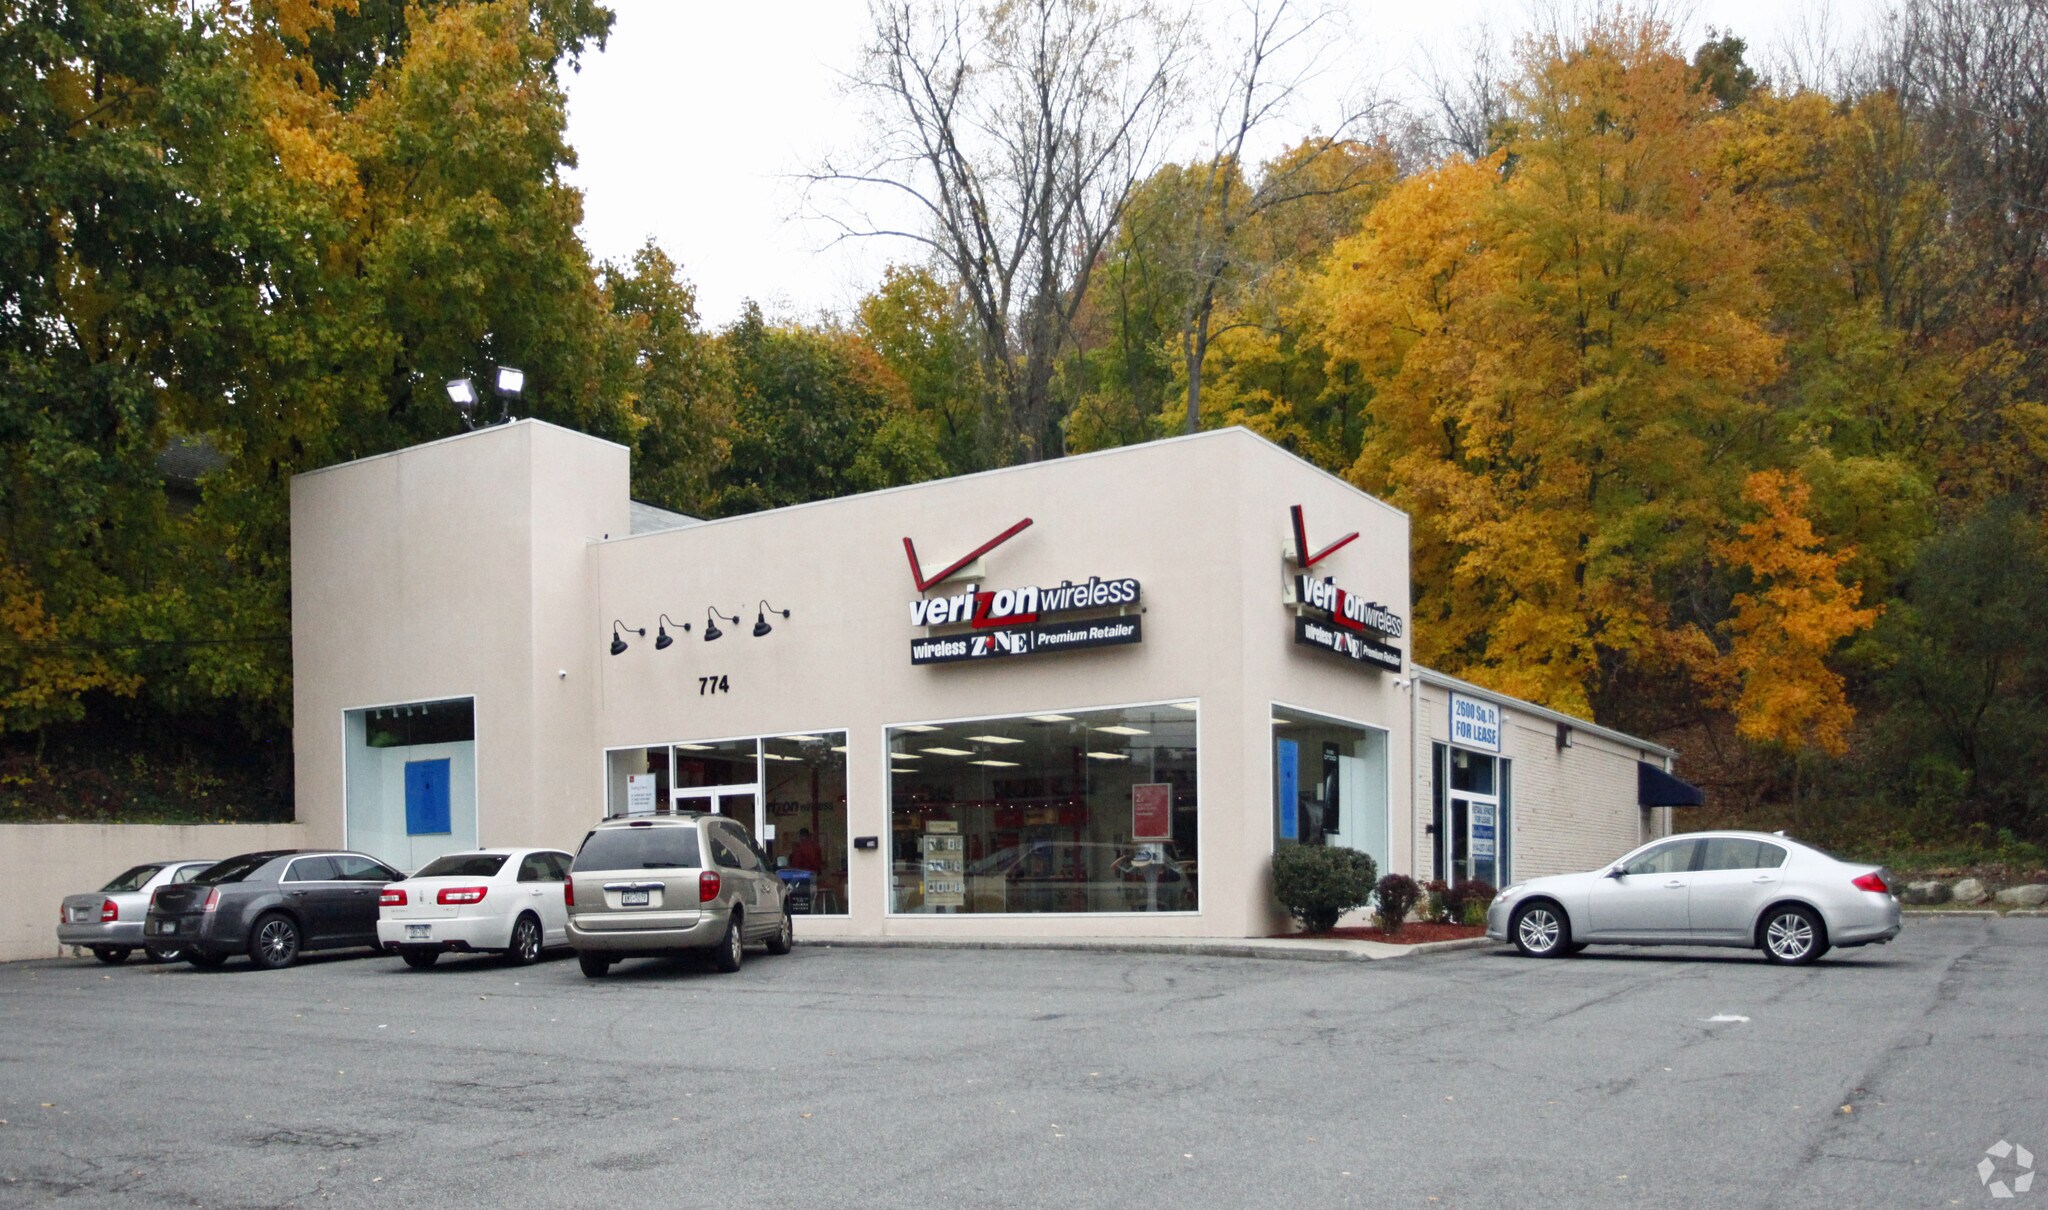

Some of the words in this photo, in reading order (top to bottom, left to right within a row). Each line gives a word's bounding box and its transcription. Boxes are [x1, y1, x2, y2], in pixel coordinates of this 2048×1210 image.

[909, 583, 1040, 628] verizon
[1041, 577, 1136, 612] wireless
[1303, 574, 1365, 631] verizon
[1365, 603, 1401, 637] wireless
[913, 640, 966, 659] wireless
[1037, 630, 1086, 645] Premium
[1089, 623, 1134, 639] Retailer
[699, 675, 730, 695] 774
[1455, 700, 1475, 719] 2600
[1456, 720, 1471, 739] FOR
[1473, 725, 1496, 745] LEASE
